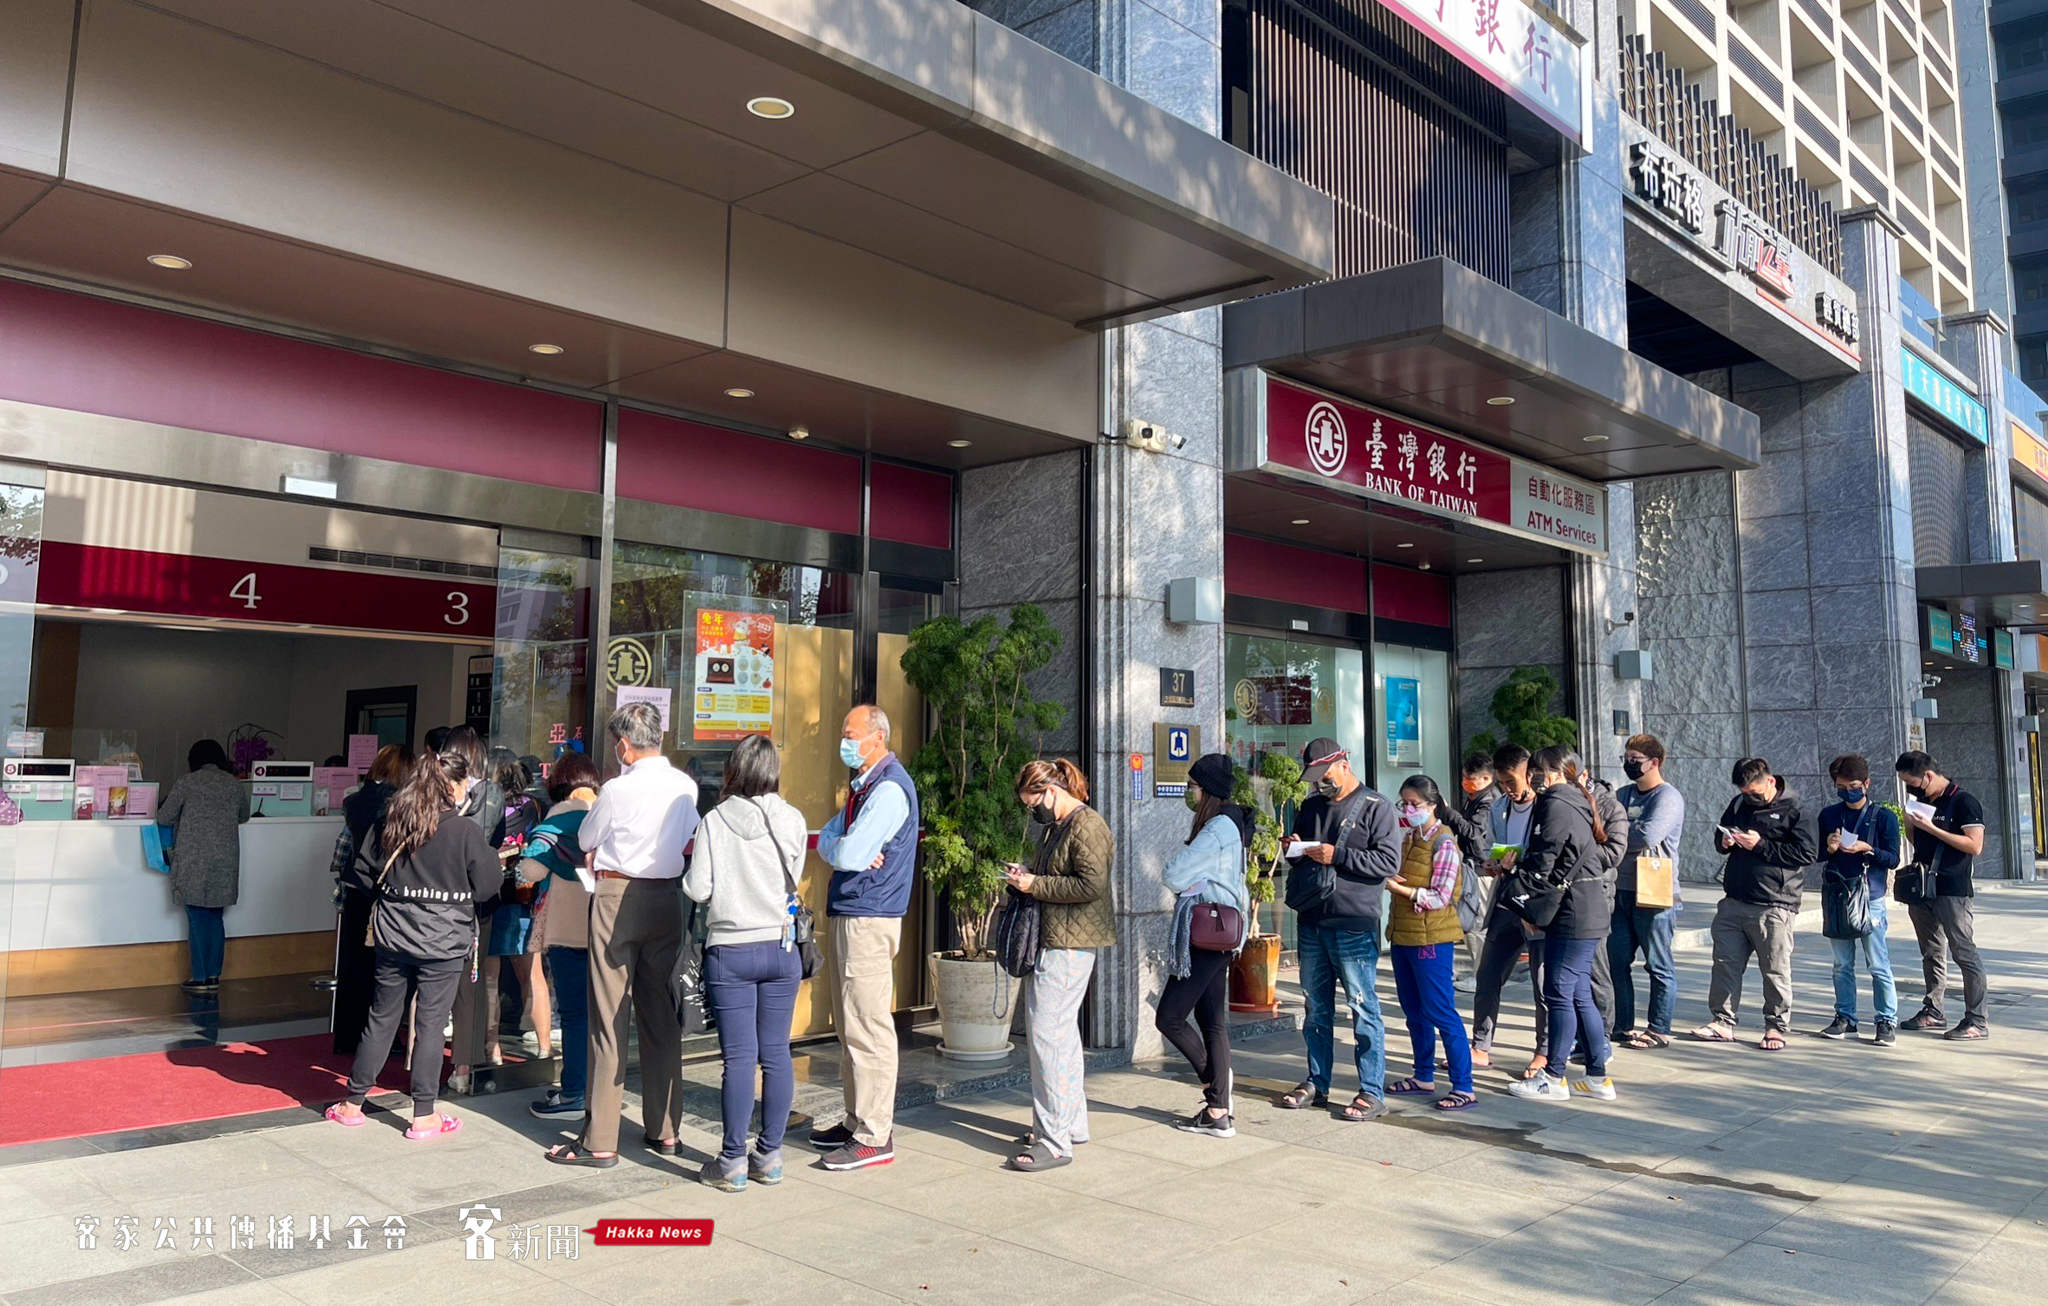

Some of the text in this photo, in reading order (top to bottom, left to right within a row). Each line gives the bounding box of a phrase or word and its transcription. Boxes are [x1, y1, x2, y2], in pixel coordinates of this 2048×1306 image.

[1435, 0, 1552, 94] 銀行
[1636, 142, 1704, 233] 布拉格
[1366, 419, 1477, 495] 臺灣銀行
[1365, 471, 1478, 516] BANK OF TAIWAN
[1527, 475, 1596, 516] 自動化服務區
[1527, 510, 1597, 545] ATM Services
[229, 572, 262, 609] 4
[444, 591, 470, 625] 3
[702, 612, 724, 625] 兔年
[756, 622, 772, 632] 2023
[1172, 672, 1186, 693] 37
[6, 765, 15, 774] 5
[256, 766, 264, 776] 4
[404, 885, 449, 902] bathing
